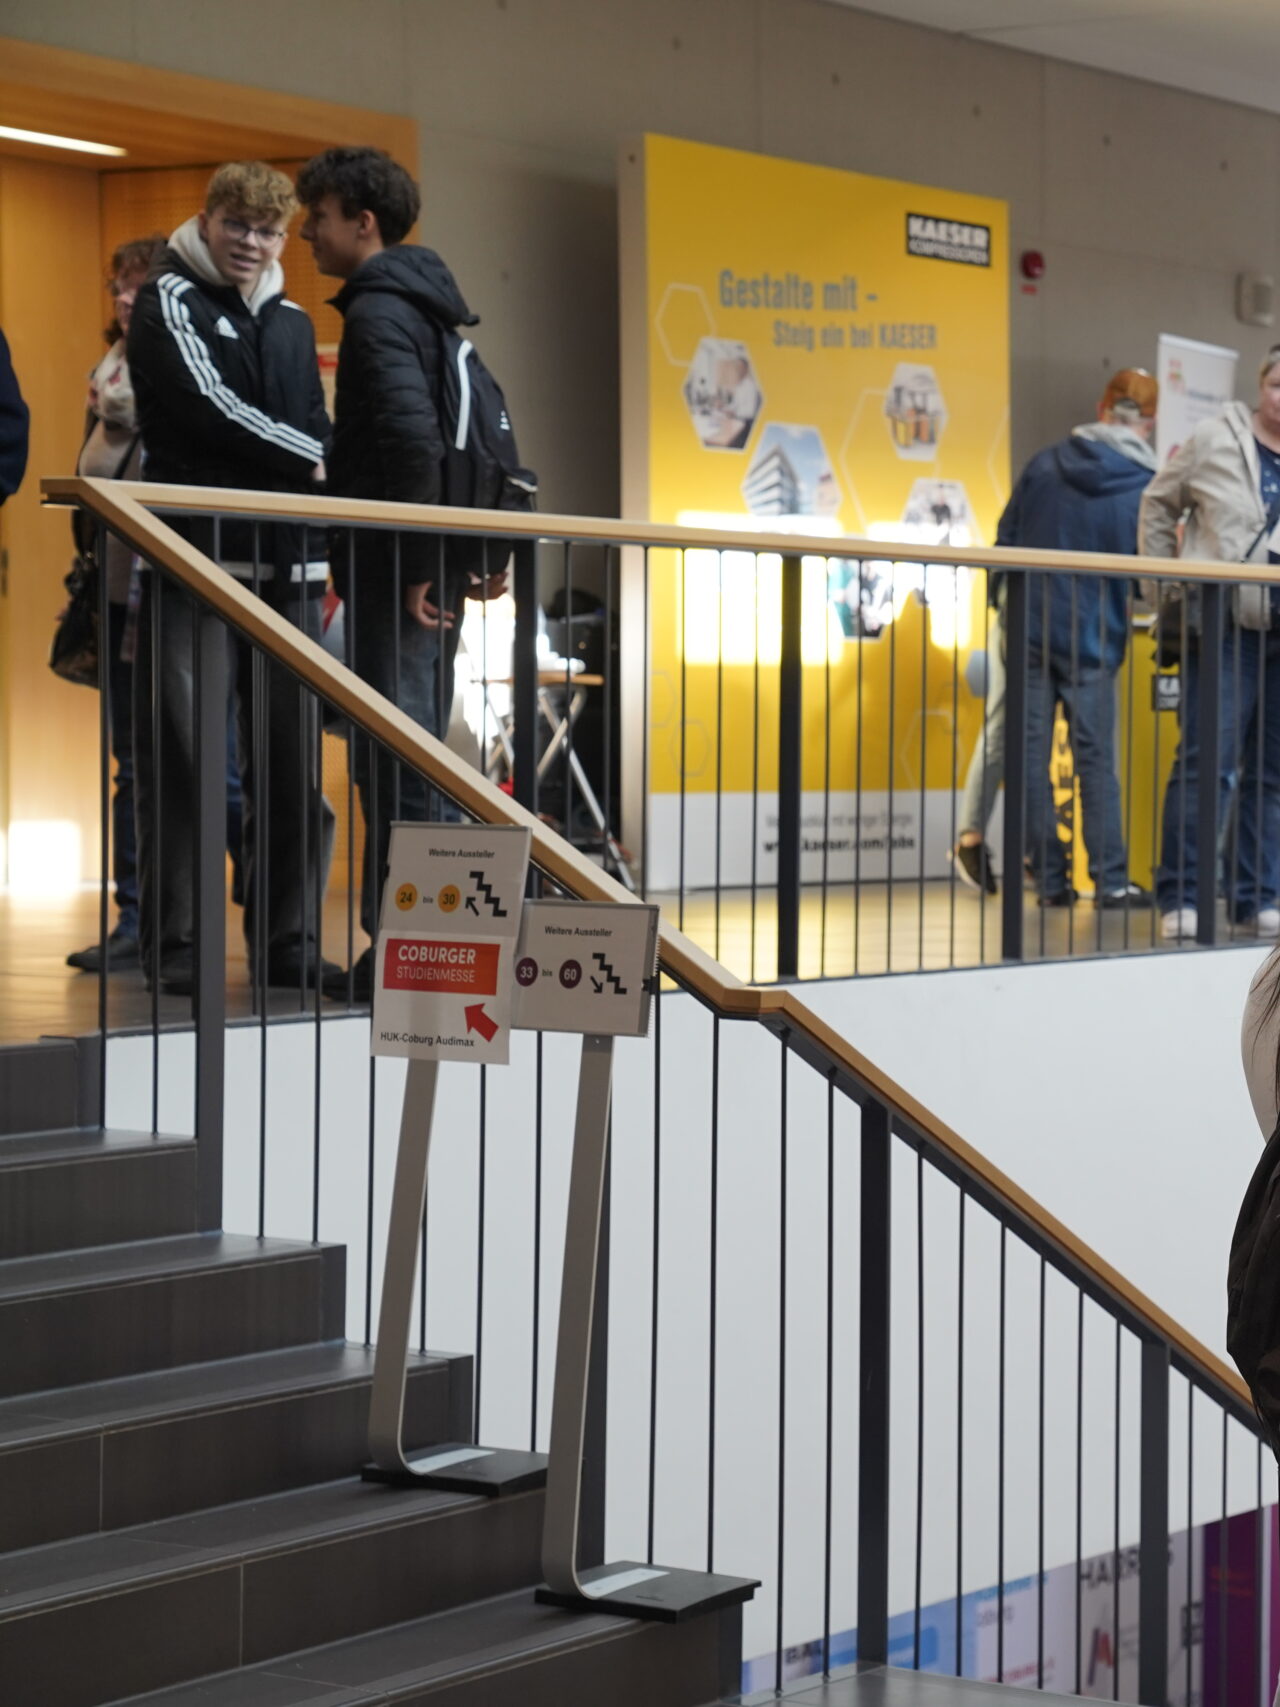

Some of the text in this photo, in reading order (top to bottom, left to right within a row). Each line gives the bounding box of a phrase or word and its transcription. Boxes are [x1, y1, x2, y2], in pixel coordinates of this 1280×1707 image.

[719, 269, 814, 311] Gestalte
[823, 275, 858, 312] mit
[773, 320, 938, 352] Steig ein bei KAESER
[428, 848, 496, 859] Weitere Aussteller
[400, 892, 413, 904] 24
[443, 894, 456, 905] 30
[544, 925, 613, 937] Weitere Aussteller
[398, 945, 477, 965] COBURGER
[396, 965, 476, 983] STUDIENMESSE
[563, 968, 577, 981] 60
[380, 1031, 475, 1048] HUK-Coburg Audimax
